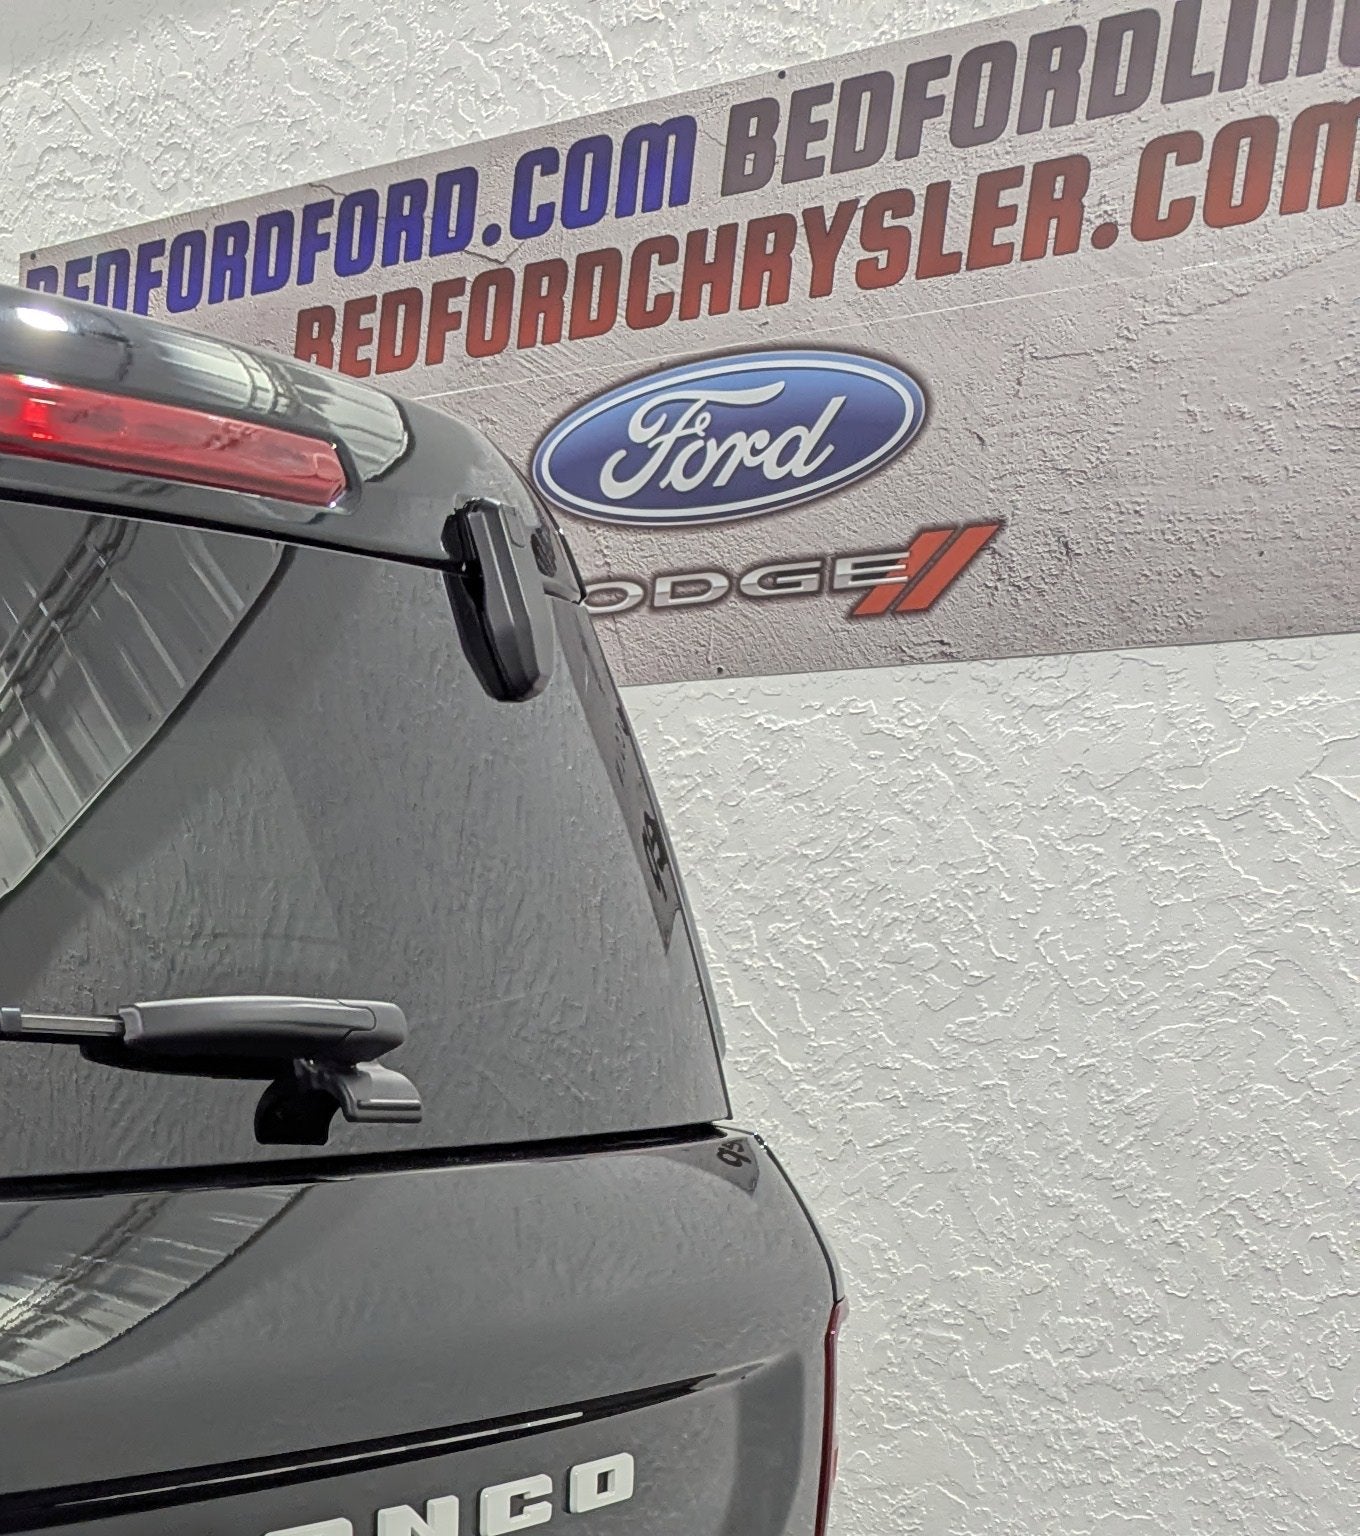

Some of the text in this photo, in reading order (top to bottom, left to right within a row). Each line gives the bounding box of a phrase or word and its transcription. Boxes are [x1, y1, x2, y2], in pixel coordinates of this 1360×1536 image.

[722, 0, 1360, 198] BEDFORDLIN
[599, 379, 847, 500] Ford
[582, 550, 910, 614] ODGE
